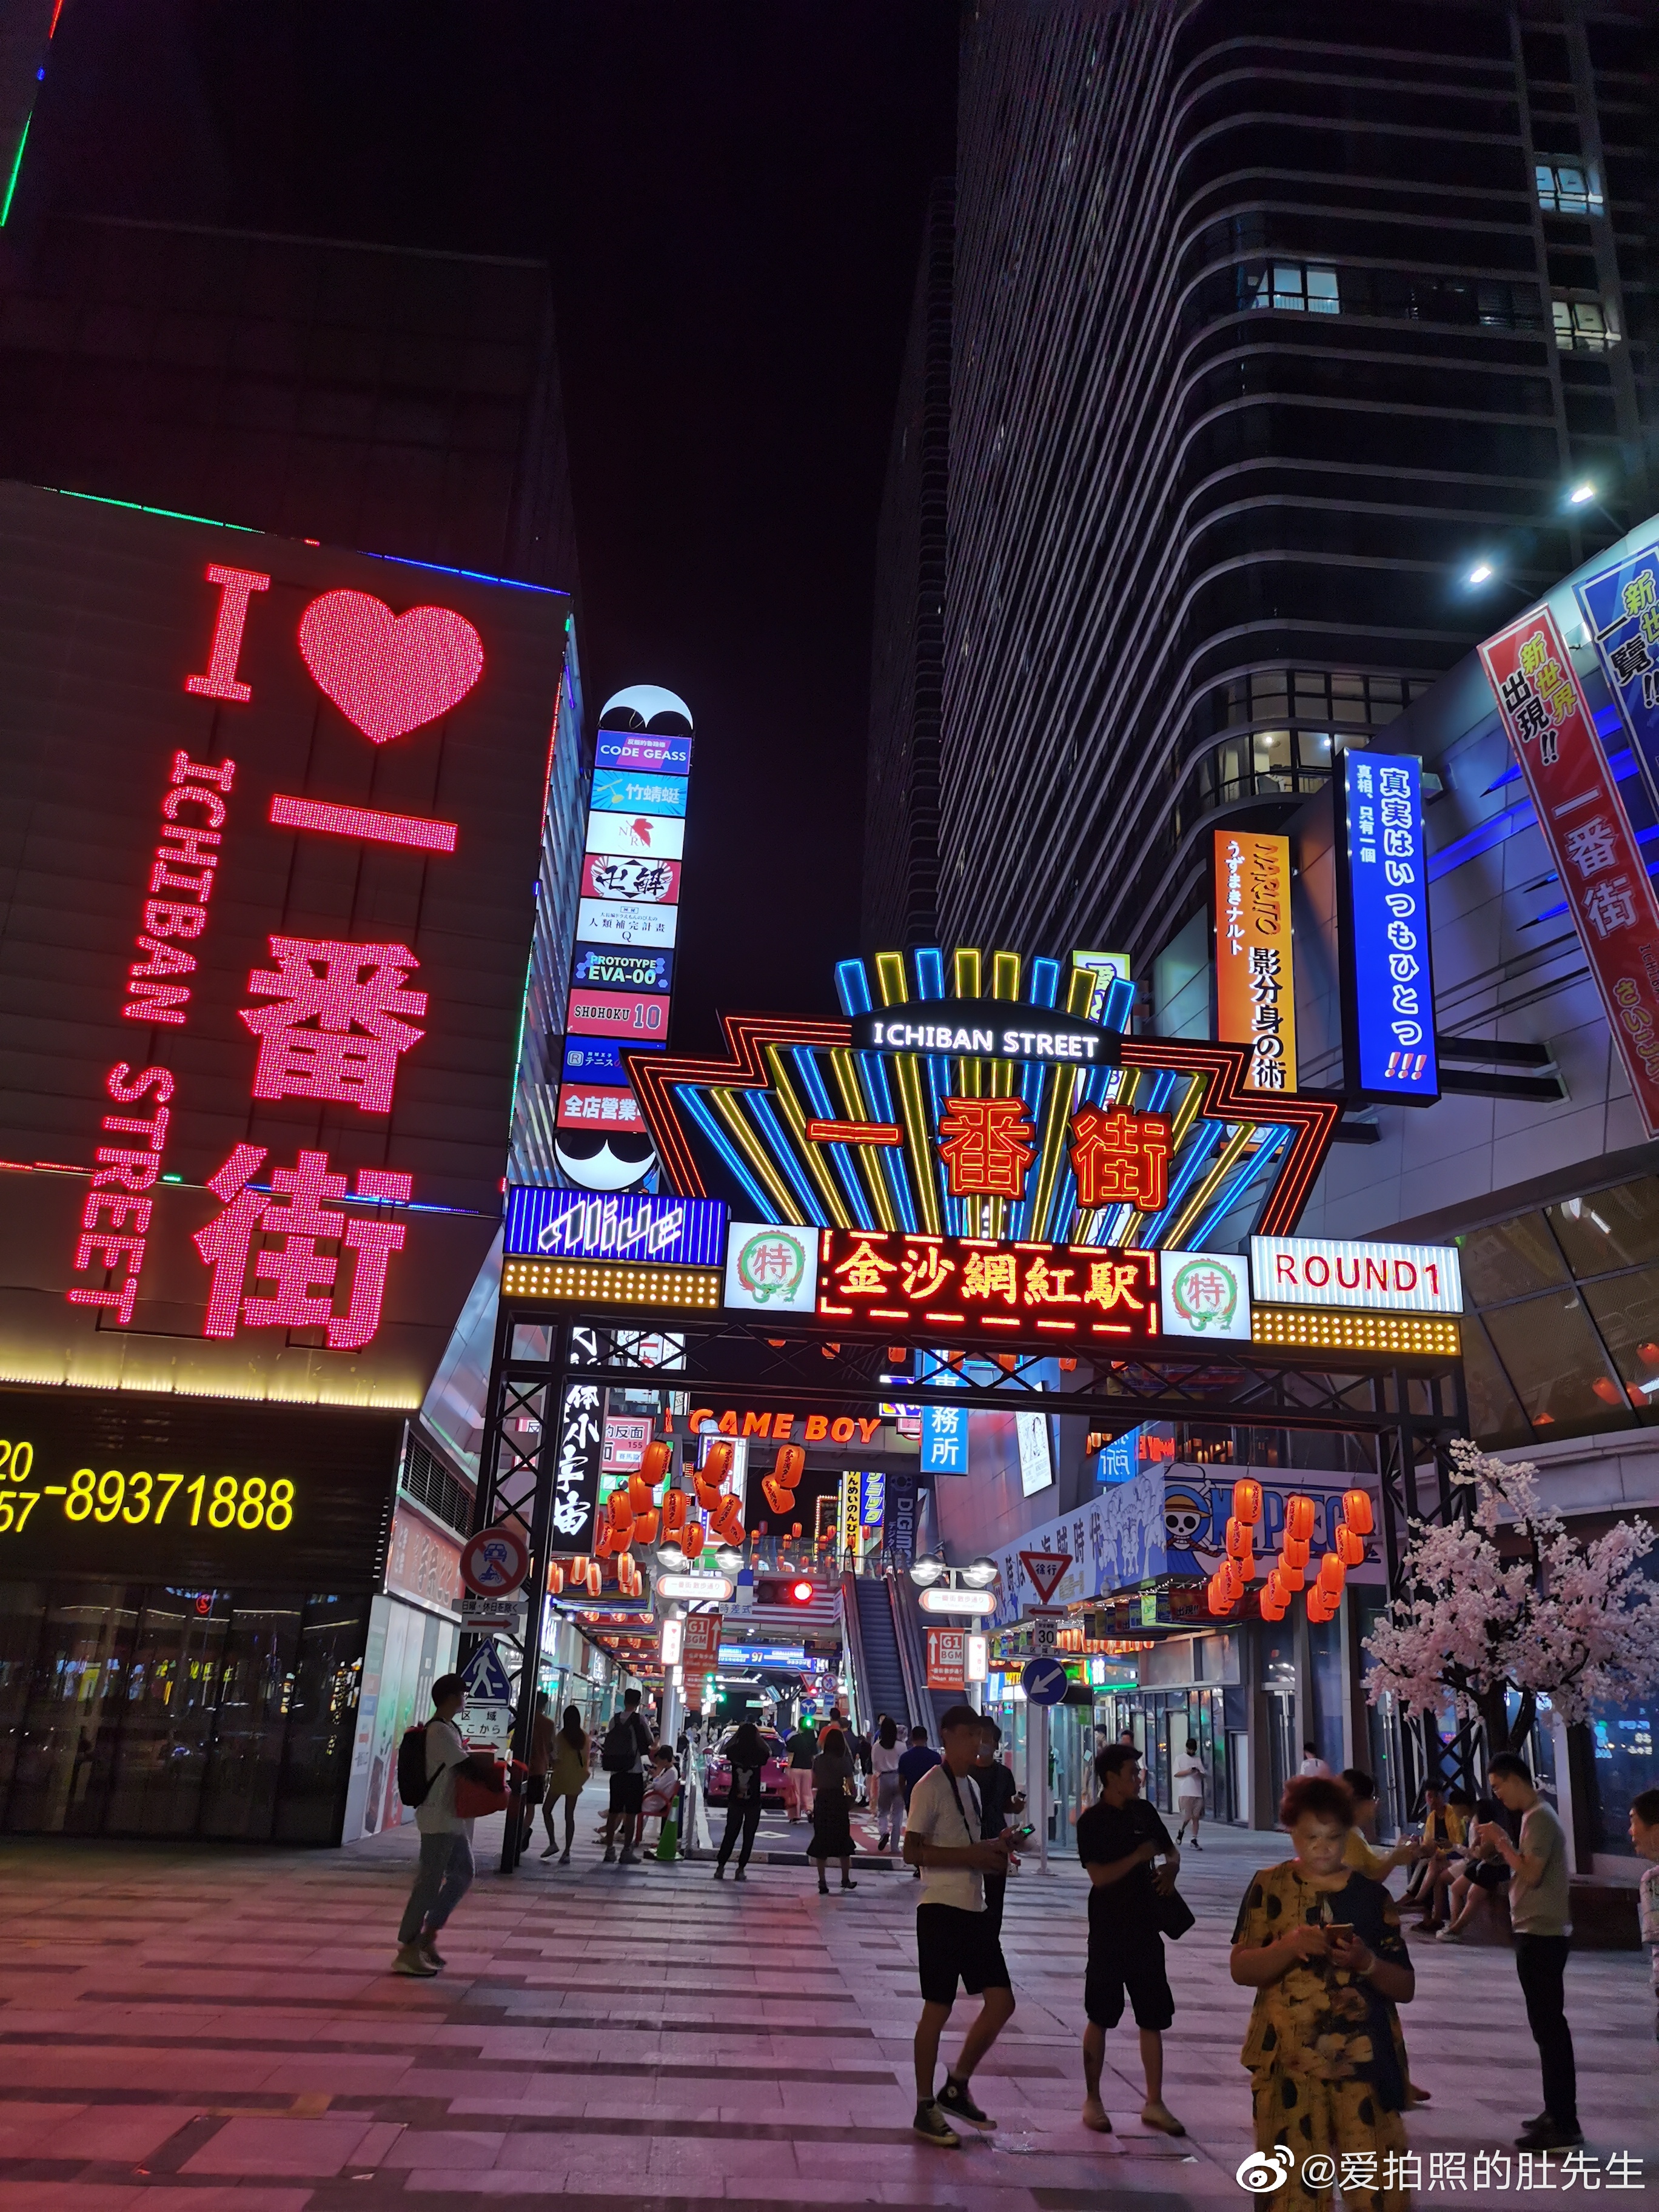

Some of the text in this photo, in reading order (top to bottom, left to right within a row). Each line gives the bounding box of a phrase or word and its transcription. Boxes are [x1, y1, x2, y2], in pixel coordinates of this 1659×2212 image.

[186, 563, 270, 702] I
[1520, 632, 1577, 725] 新世界
[1501, 670, 1558, 765] 出現!!
[600, 745, 686, 761] CODE GEASS
[626, 783, 680, 803] 竹蜻蜓
[1552, 788, 1637, 940] 一番街
[1225, 840, 1242, 956] うずまきナルト
[622, 931, 632, 942] Q
[588, 967, 656, 985] EVA-00
[590, 955, 656, 969] PROTOTYPE
[1249, 843, 1286, 1089] NARUTO 影分身の術
[1640, 943, 1659, 994] ICHIB
[574, 1004, 662, 1030] SHOHOKU 10
[68, 749, 236, 1324] ICHIBAN STREET
[874, 1022, 1099, 1058] ICHIBAN STREET
[193, 794, 458, 1349] 一番街
[564, 1095, 641, 1121] 全店營業
[806, 1096, 1174, 1211] 一番街
[538, 1199, 684, 1254] Alive
[753, 1244, 793, 1281] 特
[1187, 1275, 1228, 1309] 特
[689, 1409, 881, 1444] GAME BOY
[1036, 1563, 1057, 1575] 徐行
[720, 1603, 752, 1614] 時差式
[688, 1621, 705, 1633] G1
[943, 1637, 960, 1648] G1
[1038, 1630, 1054, 1644] 30
[751, 1652, 763, 1663] 97
[458, 1723, 500, 1735] こから
